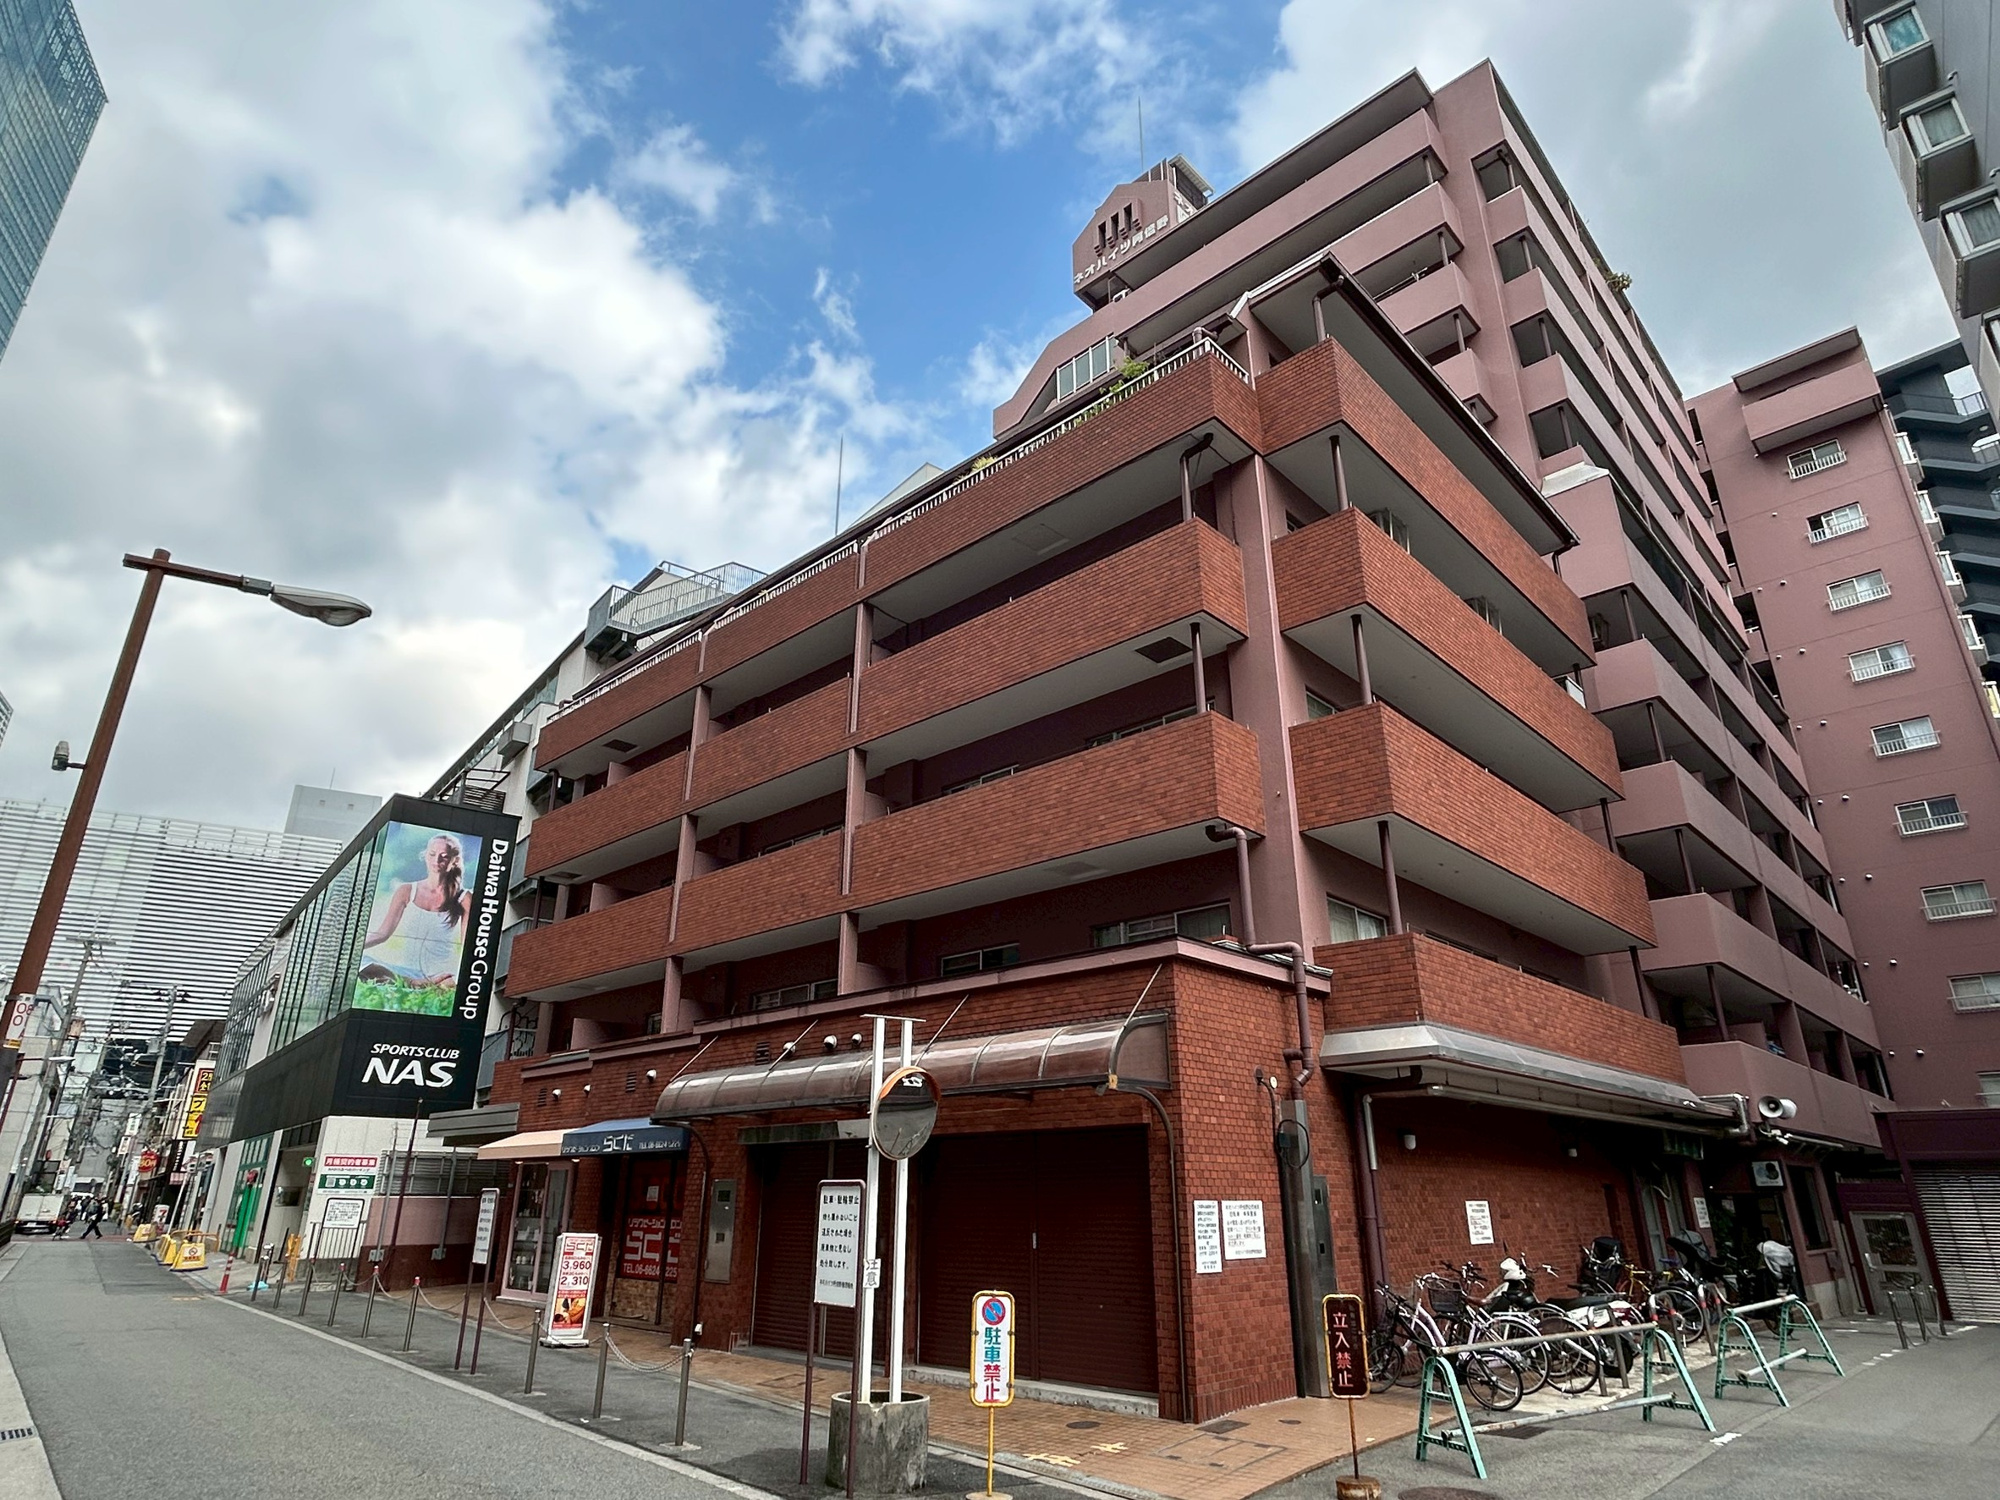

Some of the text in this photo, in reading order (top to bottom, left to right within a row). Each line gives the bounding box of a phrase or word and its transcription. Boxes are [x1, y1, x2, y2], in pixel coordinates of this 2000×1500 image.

[459, 838, 509, 1020] Daiwa House Group
[361, 1057, 457, 1088] NAS
[560, 1275, 589, 1286] 2,310
[562, 1260, 592, 1271] 3,960
[866, 1260, 879, 1287] 注意
[983, 1327, 1002, 1403] 駐車禁止
[1332, 1312, 1354, 1387] 立入禁止
